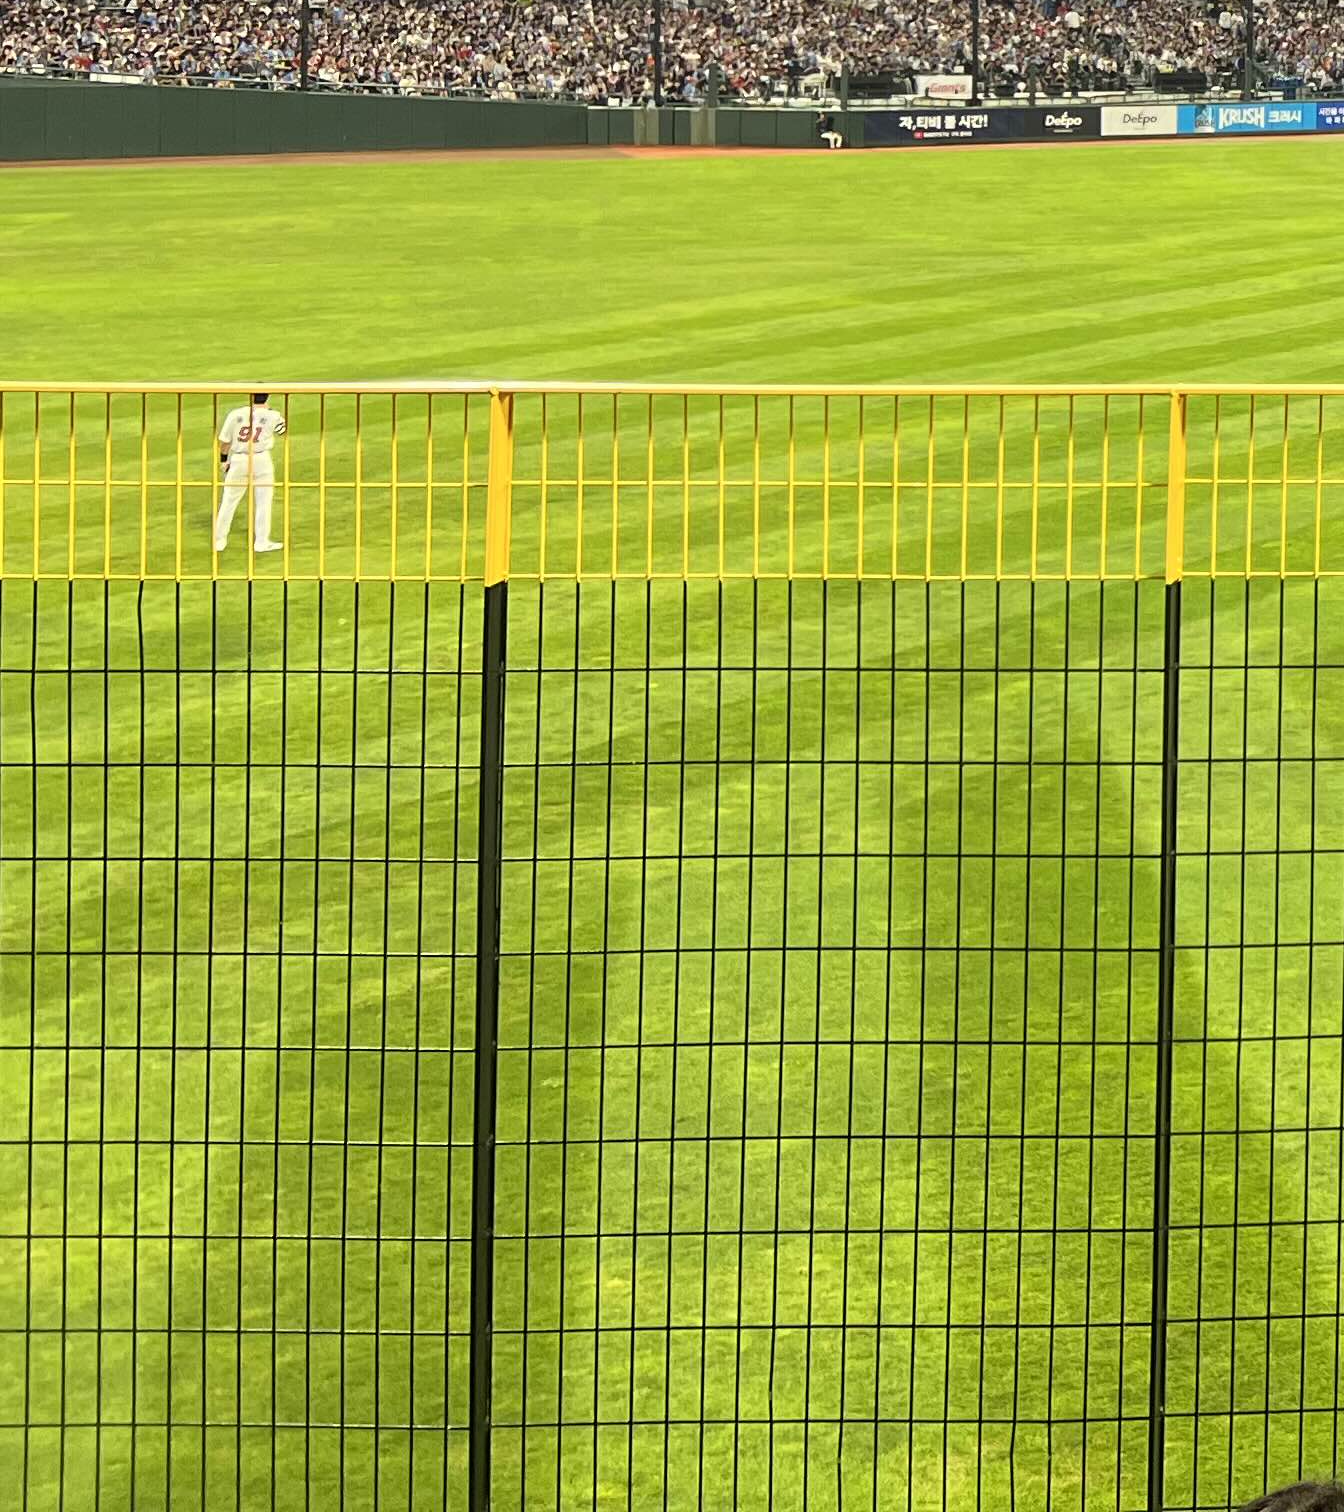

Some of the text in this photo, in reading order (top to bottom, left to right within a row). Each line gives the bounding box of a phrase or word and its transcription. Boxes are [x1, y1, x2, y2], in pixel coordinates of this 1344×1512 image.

[958, 114, 988, 129] 시간!
[1218, 106, 1266, 130] KRUSH
[237, 425, 263, 444] 91
